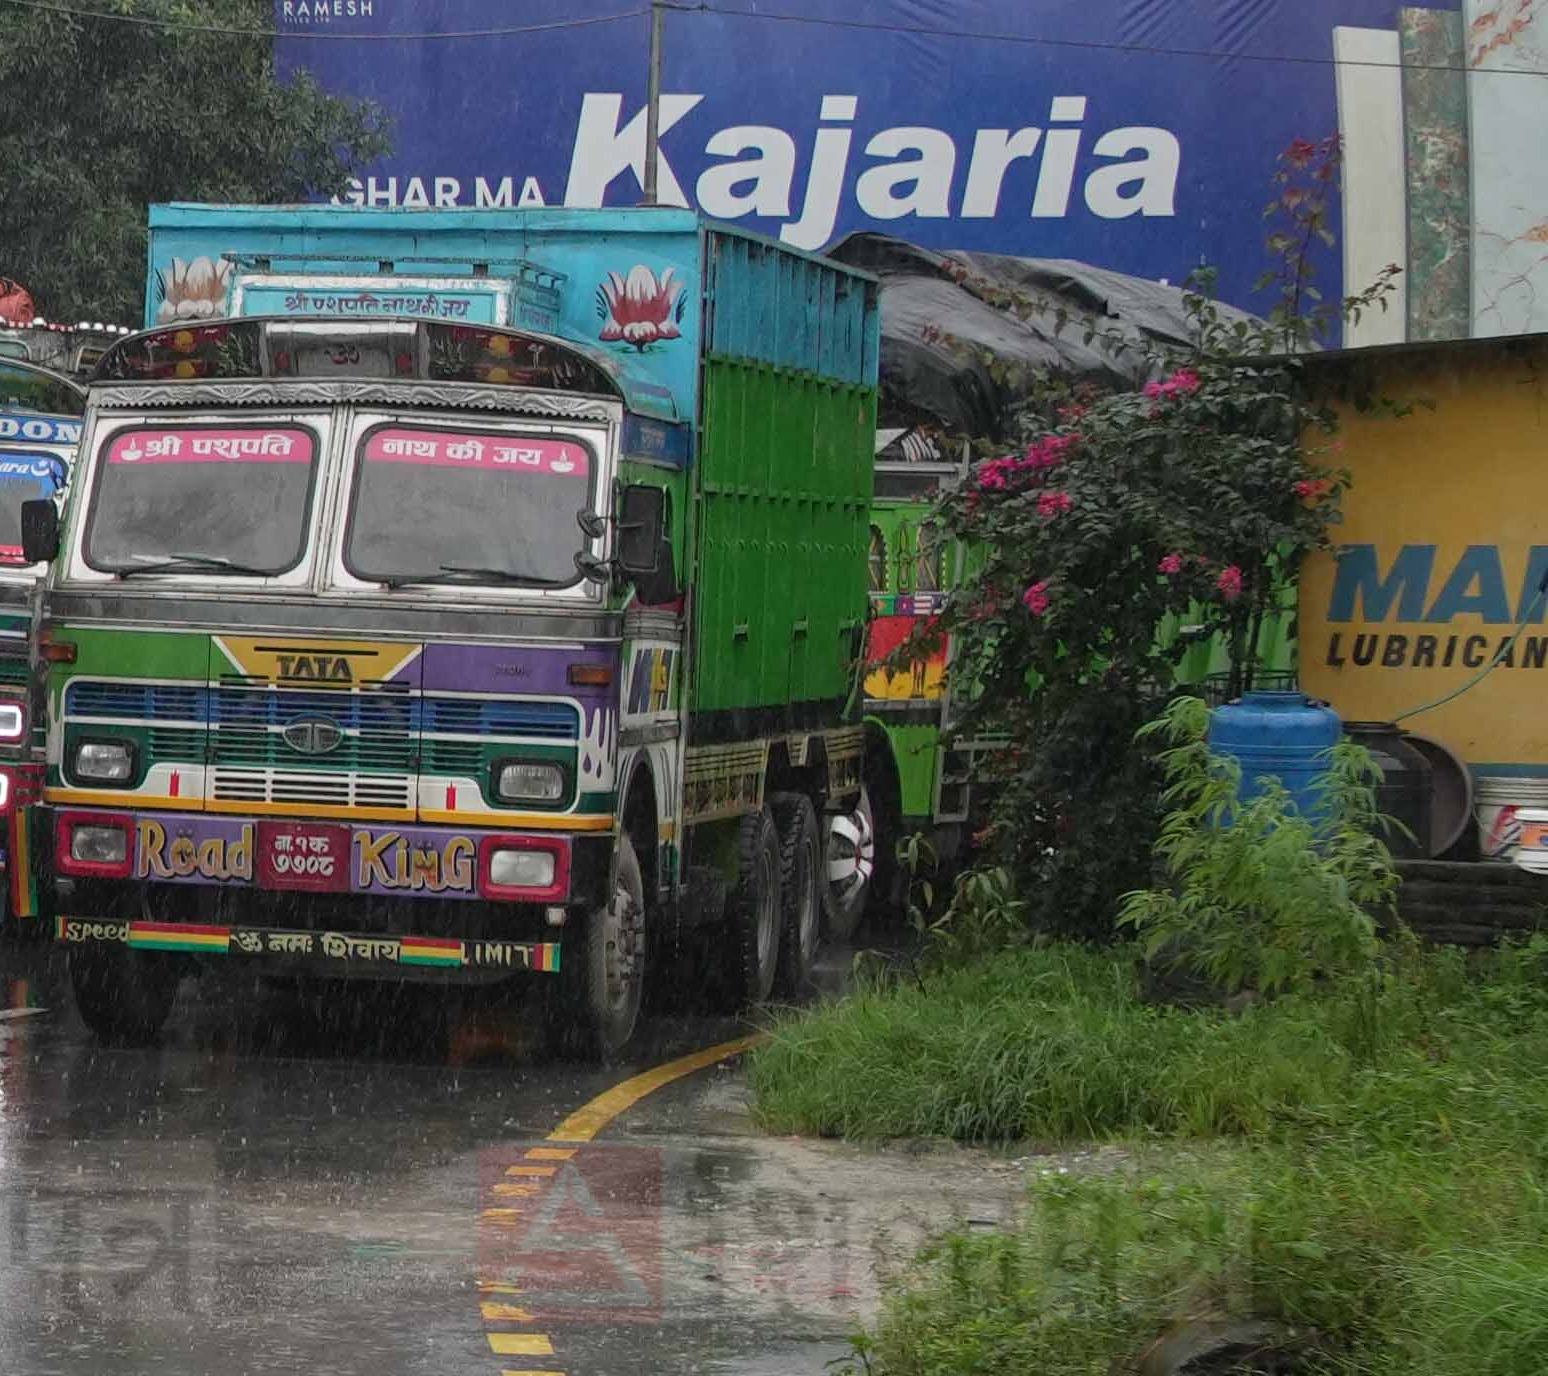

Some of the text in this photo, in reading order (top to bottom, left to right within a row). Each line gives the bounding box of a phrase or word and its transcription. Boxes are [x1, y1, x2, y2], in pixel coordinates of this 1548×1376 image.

[283, 0, 373, 16] RAMESH
[564, 92, 1180, 252] Kajaria
[144, 436, 296, 457] श्री पशुपति
[382, 439, 543, 465] नाथ की जय
[276, 655, 353, 680] TATA
[138, 820, 253, 880] Road
[321, 932, 399, 960] शिवाय
